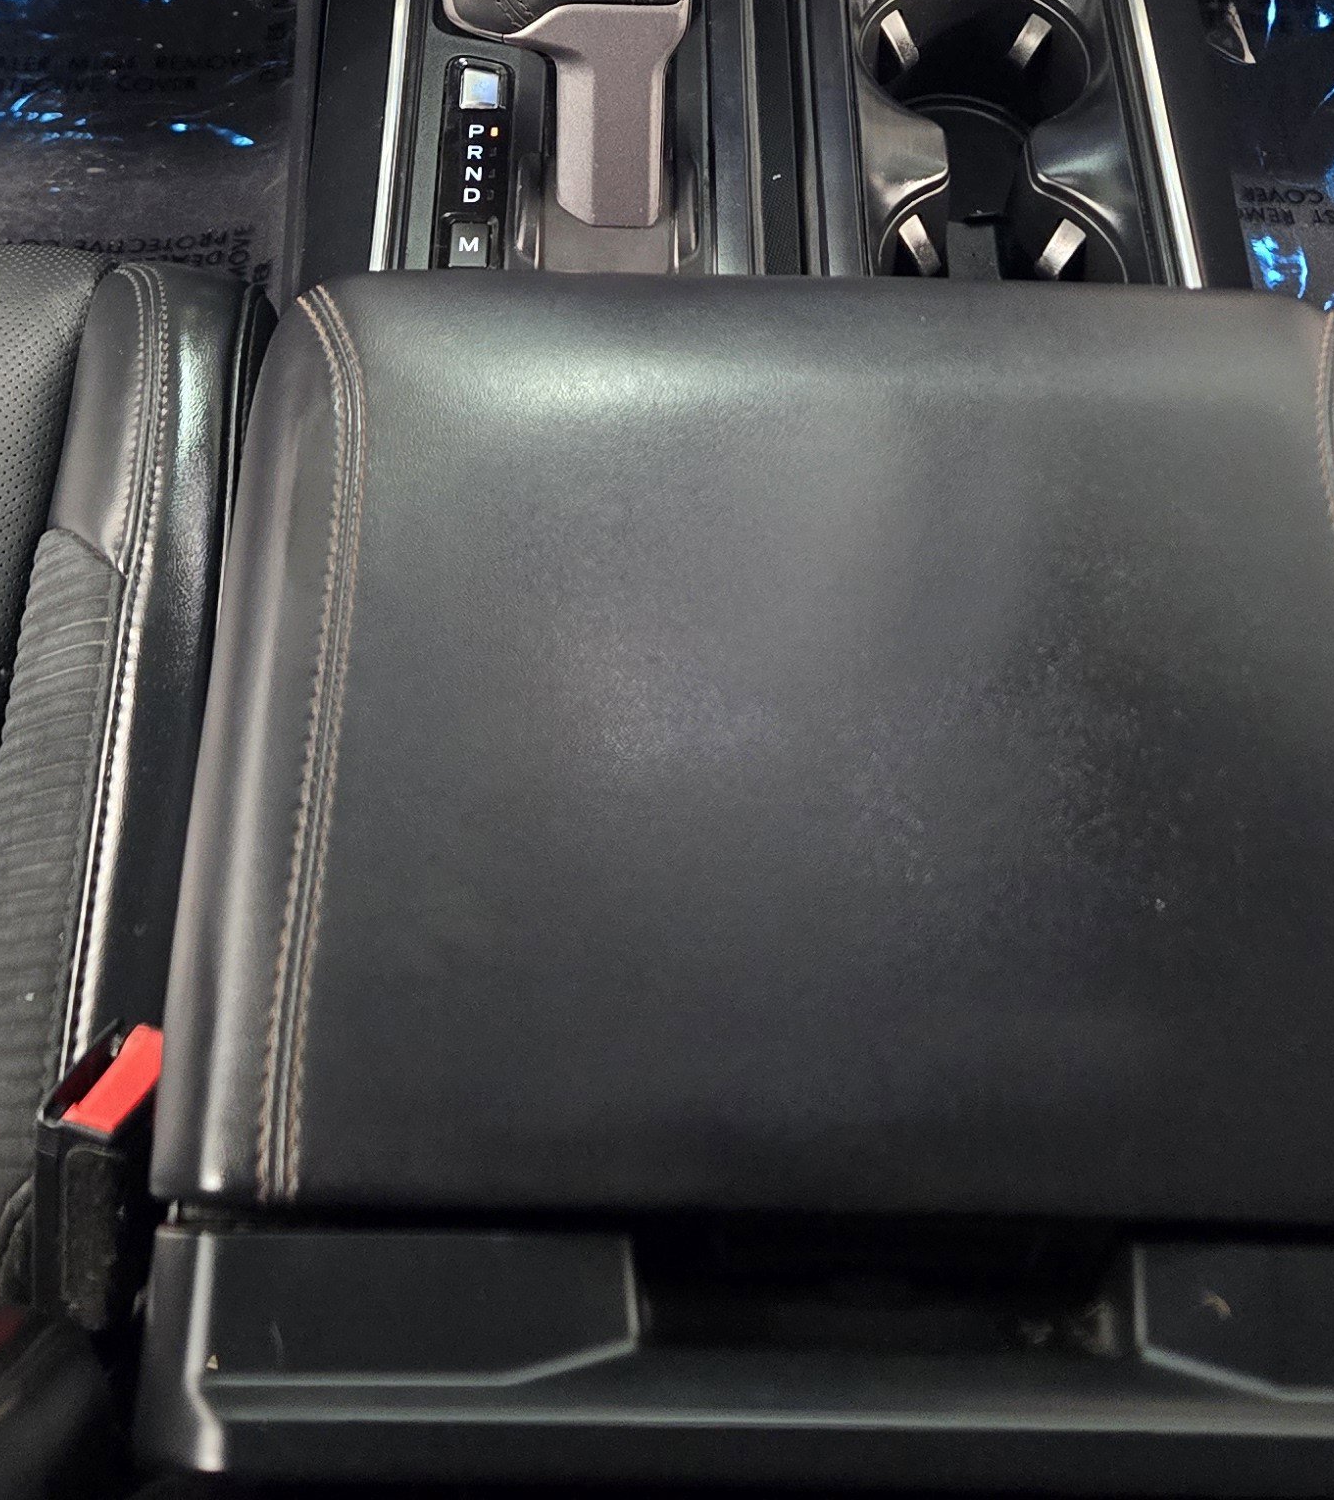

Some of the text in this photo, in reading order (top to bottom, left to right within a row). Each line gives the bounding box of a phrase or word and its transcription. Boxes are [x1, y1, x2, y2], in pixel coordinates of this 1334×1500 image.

[468, 123, 485, 139] P
[467, 145, 483, 160] R
[465, 167, 482, 182] N
[463, 187, 481, 203] D
[458, 237, 479, 252] M
